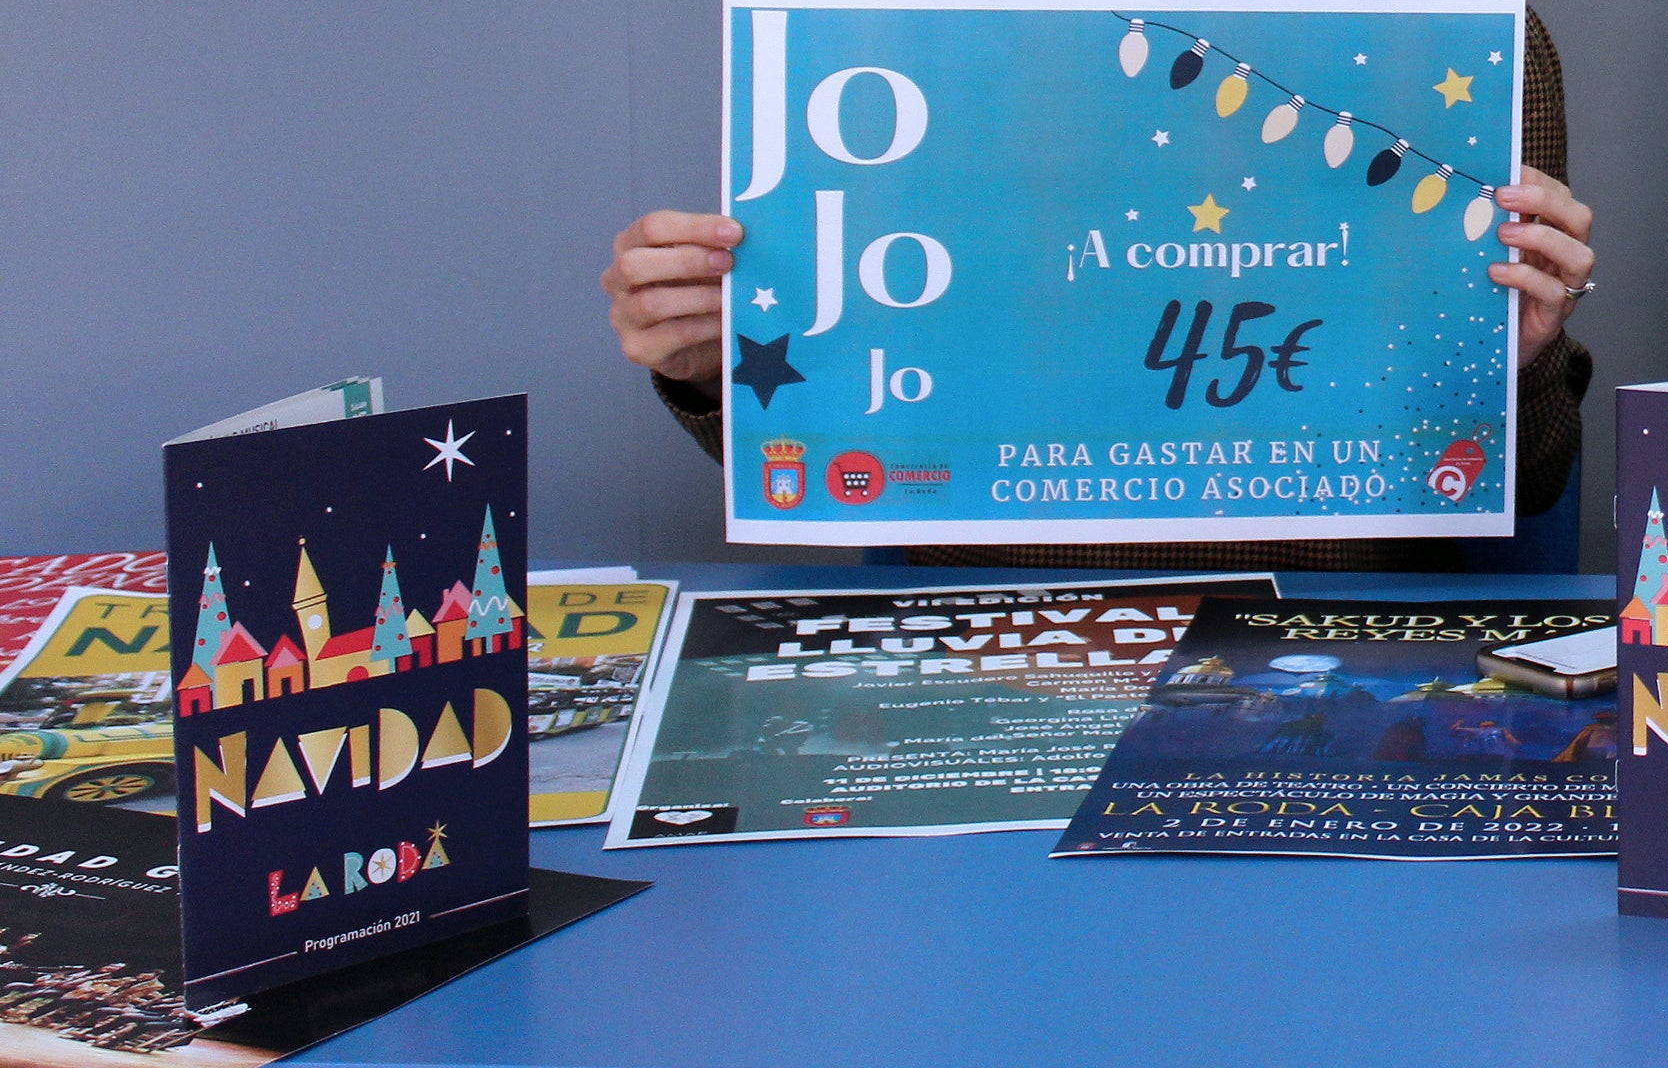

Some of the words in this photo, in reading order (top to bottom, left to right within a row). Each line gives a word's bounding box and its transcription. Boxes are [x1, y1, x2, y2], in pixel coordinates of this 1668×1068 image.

[733, 10, 928, 202] Jo
[1066, 229, 1107, 283] ¡A
[1126, 222, 1350, 278] comprar!
[804, 191, 953, 337] Jo
[864, 349, 933, 416] Jo
[998, 443, 1093, 468] PARA
[1109, 440, 1253, 466] GASTAR
[1269, 440, 1316, 464] EN
[1333, 439, 1381, 463] UN
[888, 470, 951, 482] COMERCIO
[991, 477, 1185, 503] COMERCIO
[1201, 474, 1386, 501] ASOCIADO
[559, 589, 650, 607] DE
[796, 606, 1195, 635] FESTIVAL
[1458, 614, 1498, 628] Y
[1281, 628, 1467, 641] REYES
[777, 629, 1087, 657] LLUVIA
[922, 674, 1018, 686] Escudero
[1026, 678, 1106, 687] Carmen
[879, 699, 965, 710] Eugenio
[194, 688, 512, 833] NAVIDAD
[833, 756, 1024, 772] AUDIOVISUALES:
[847, 750, 971, 763] PRESENTA:
[855, 775, 888, 783] DE
[894, 768, 1030, 782] DICIEMBRE
[1185, 772, 1224, 781] LA
[1245, 772, 1415, 782] HISTORIA
[1433, 772, 1548, 782] JAMÁS
[831, 780, 968, 793] AUDITORIO
[974, 779, 1007, 787] DE
[1014, 777, 1047, 785] LA
[1112, 781, 1160, 790] UNA
[1166, 781, 1229, 790] OBRA
[1236, 781, 1269, 790] DE
[1272, 781, 1362, 791] TEATRO
[1387, 782, 1420, 791] UN
[1426, 782, 1558, 792] CONCIERTO
[1564, 784, 1597, 792] DE
[1136, 790, 1171, 799] UN
[1178, 789, 1355, 800] ESPECTÁCULO
[1360, 791, 1395, 801] DE
[1400, 791, 1485, 801] MAGIA
[1492, 792, 1509, 801] Y
[1103, 800, 1165, 817] LA
[1189, 800, 1354, 817] RODA
[1410, 803, 1545, 820] CAJA
[1163, 818, 1183, 829] 2
[1201, 818, 1248, 829] DE
[1268, 819, 1399, 831] ENERO
[1419, 821, 1465, 832] DE
[1483, 821, 1564, 832] 2022
[1099, 832, 1169, 840] VENTA
[1178, 831, 1207, 839] DE
[1215, 831, 1332, 840] ENTRADAS
[1339, 832, 1369, 841] EN
[1408, 834, 1466, 843] CASA
[1472, 834, 1501, 843] DE
[1509, 834, 1541, 843] LA
[268, 865, 330, 917] LA
[343, 820, 452, 896] RODA
[304, 917, 392, 954] Programación
[394, 909, 421, 932] 2021
